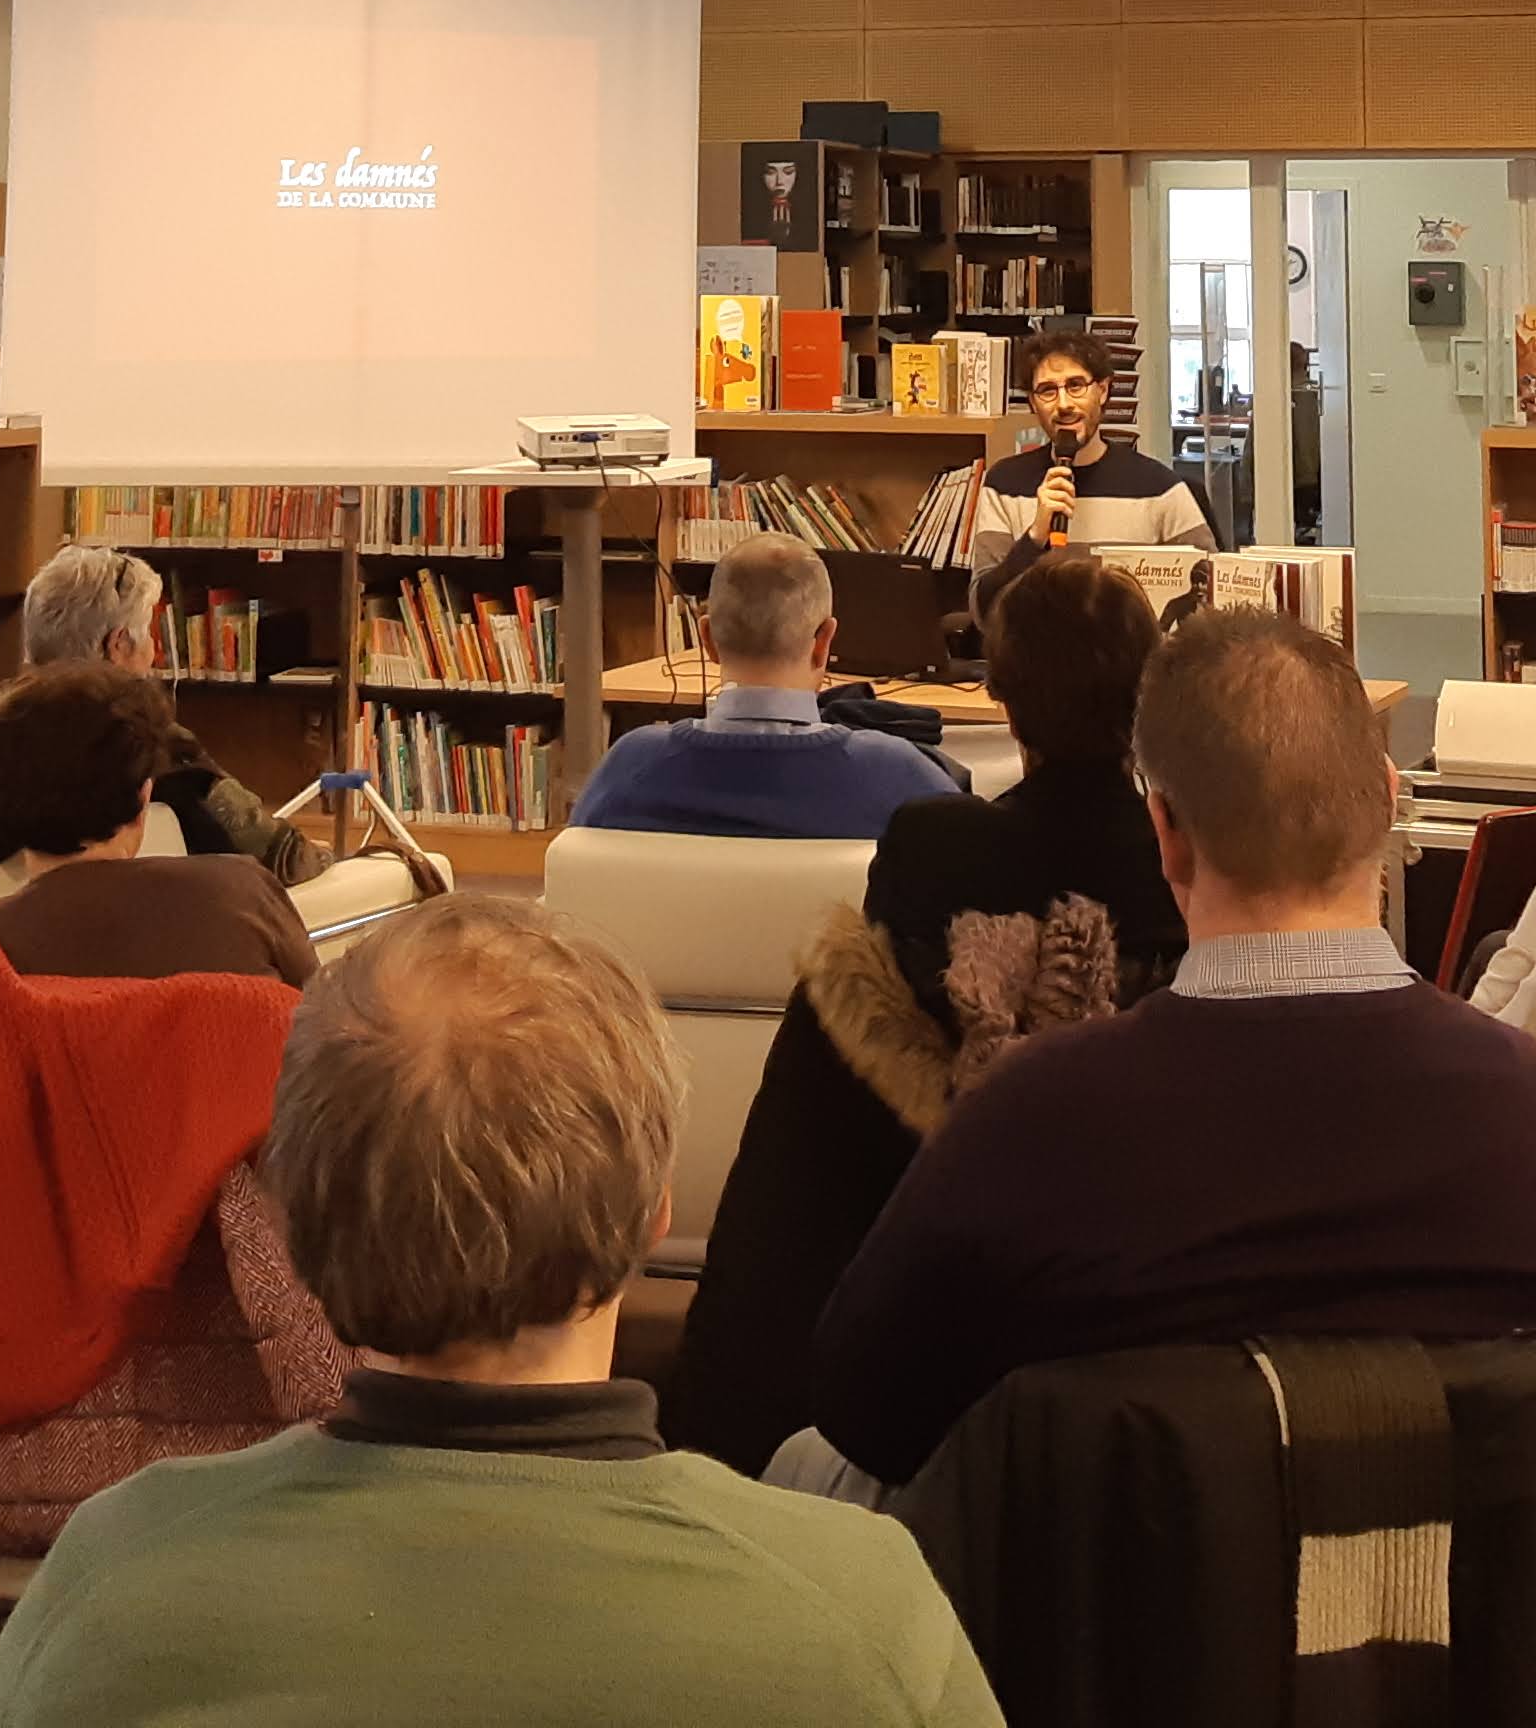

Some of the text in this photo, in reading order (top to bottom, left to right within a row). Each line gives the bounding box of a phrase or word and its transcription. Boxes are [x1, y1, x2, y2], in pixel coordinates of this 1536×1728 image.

[279, 145, 438, 188] Les damnés
[276, 191, 436, 208] DE LA COMMUNE
[1134, 558, 1184, 578] damnés
[1216, 570, 1230, 583] Les
